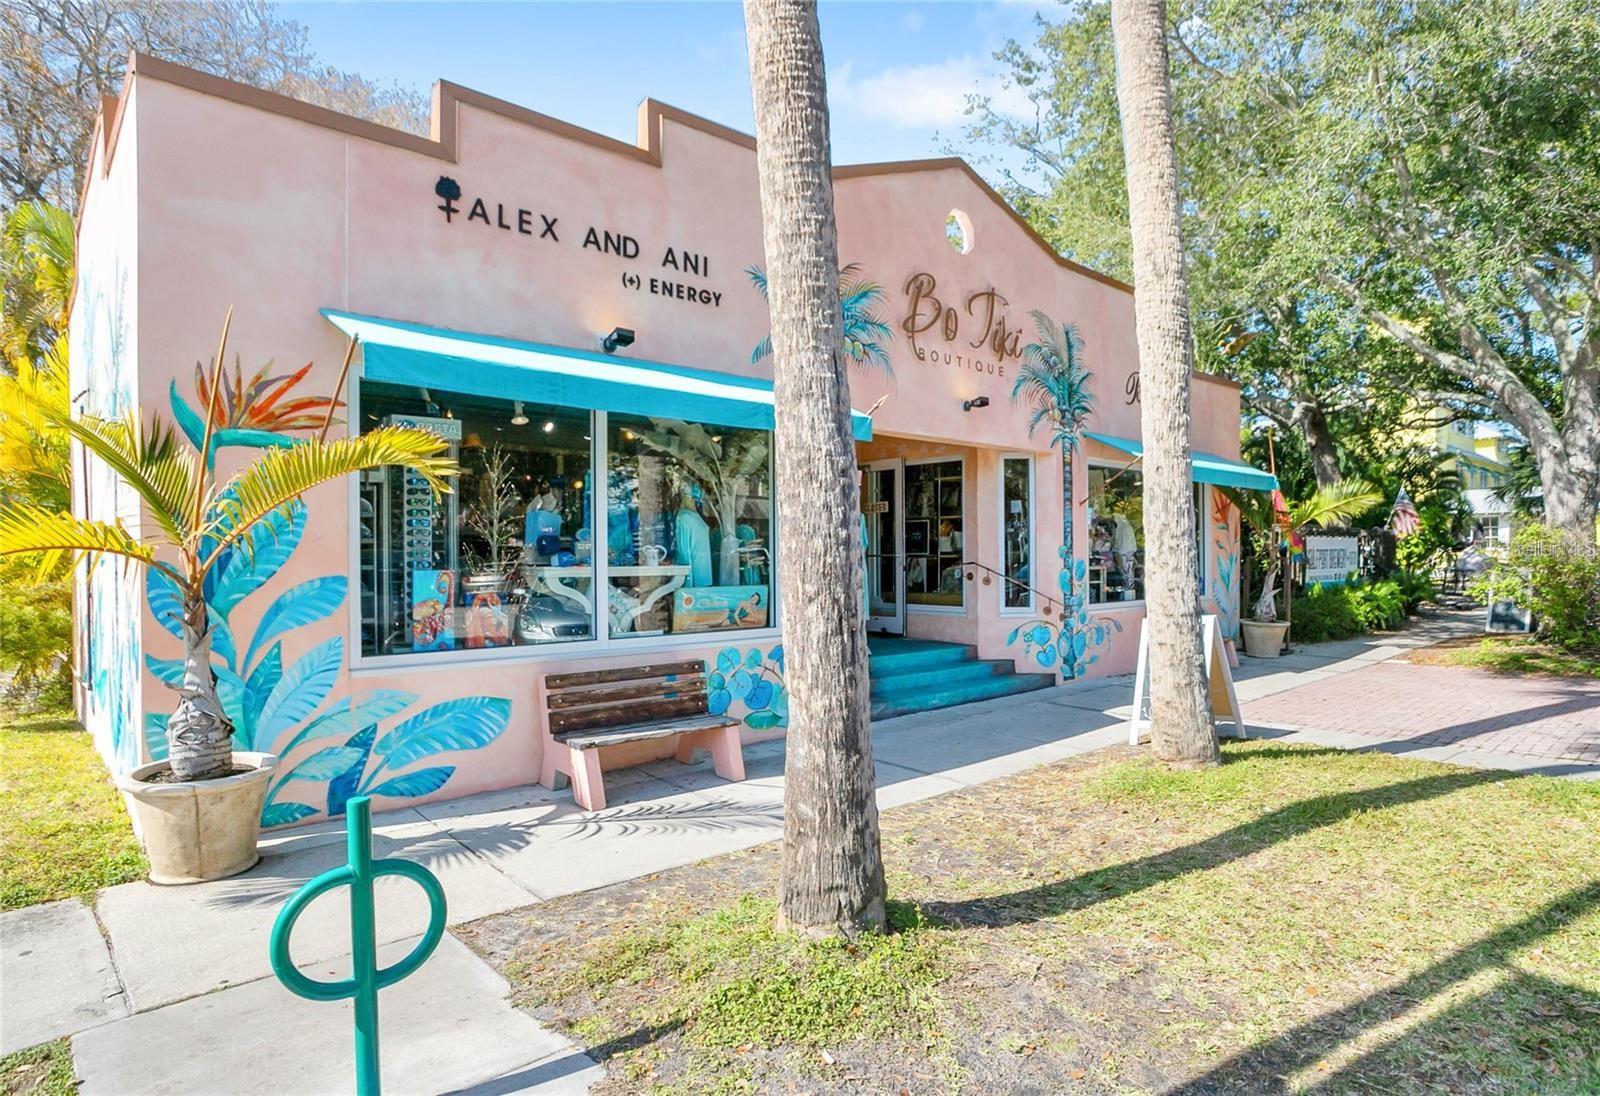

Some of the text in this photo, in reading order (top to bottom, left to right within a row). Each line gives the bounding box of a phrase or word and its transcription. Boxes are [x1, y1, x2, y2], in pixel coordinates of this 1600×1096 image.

[467, 198, 708, 277] ALEX AND ANI
[650, 278, 722, 307] ENERGY
[903, 273, 1023, 361] Bo Tiki
[917, 348, 1005, 377] BOUTIQUE
[864, 502, 886, 512] CLOSED
